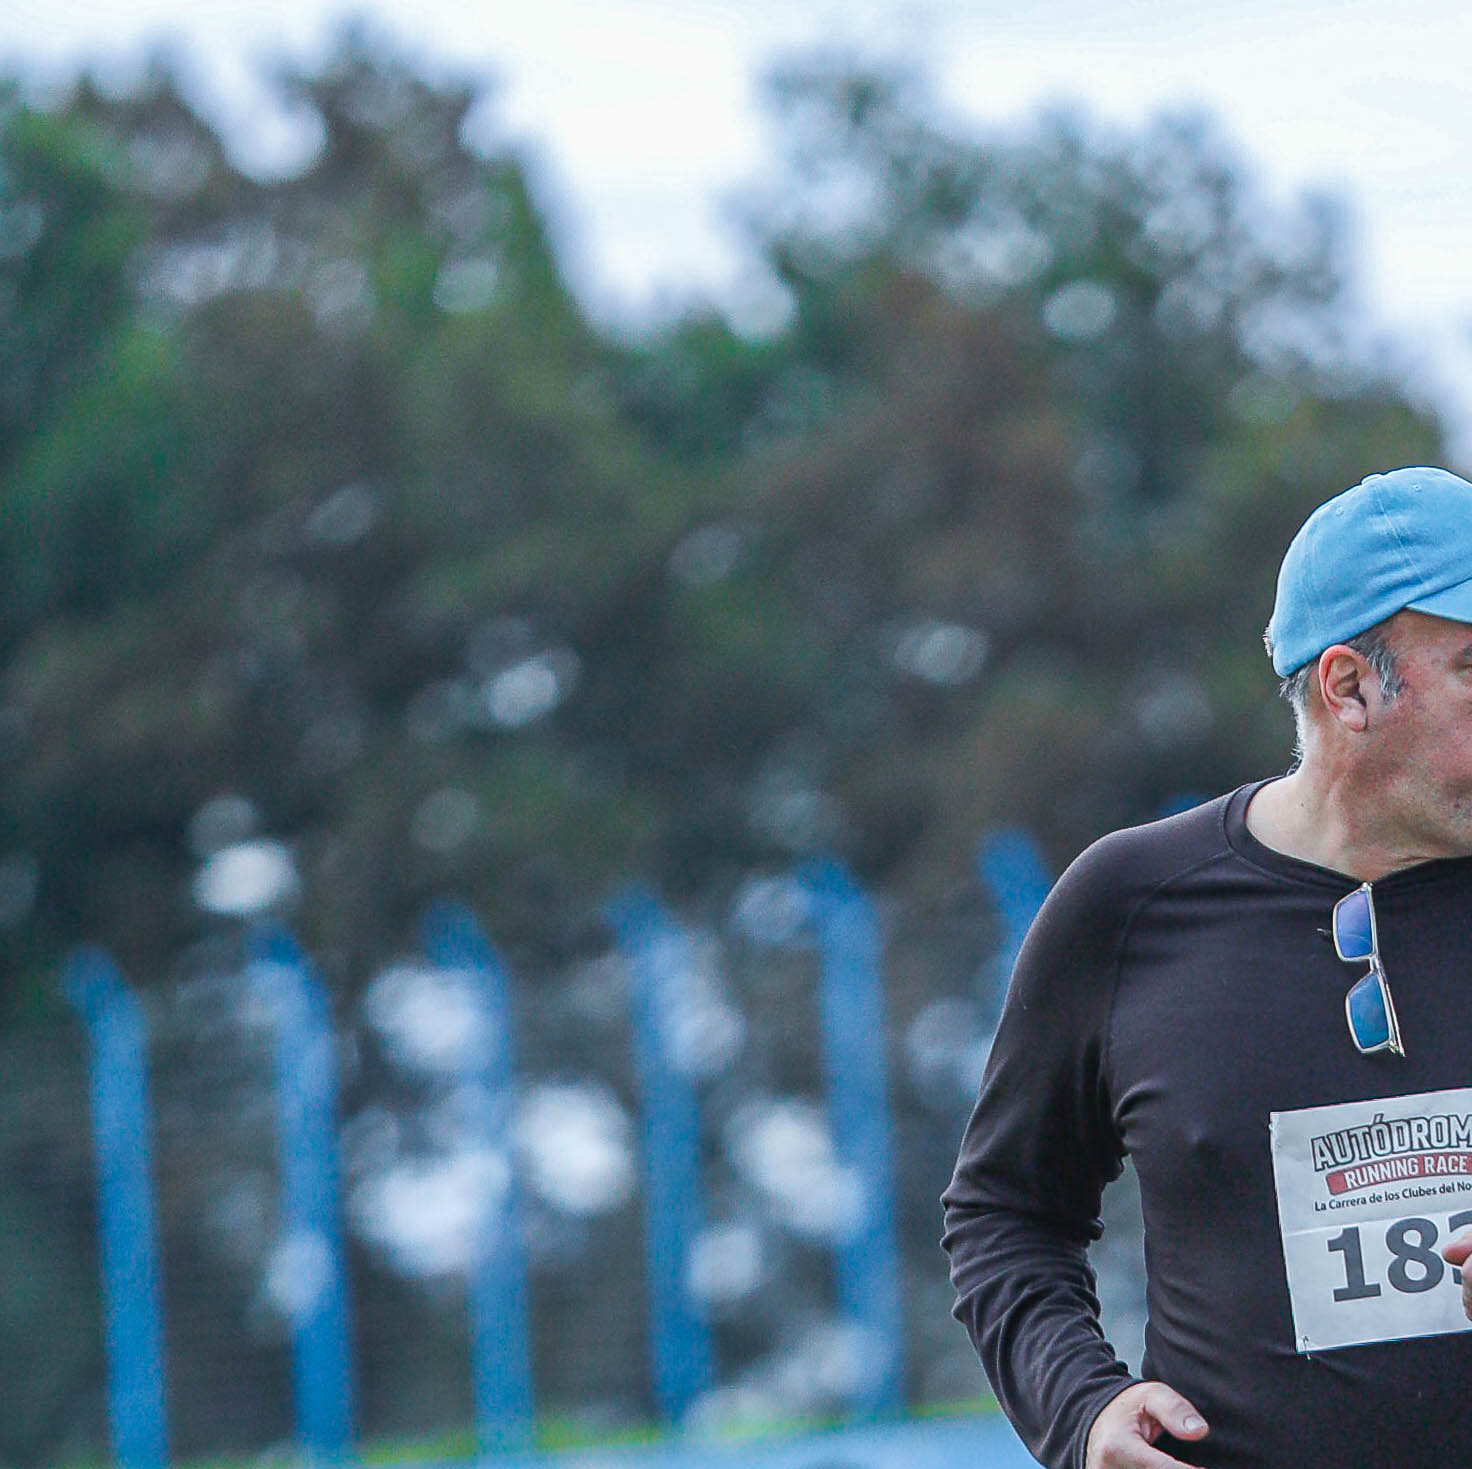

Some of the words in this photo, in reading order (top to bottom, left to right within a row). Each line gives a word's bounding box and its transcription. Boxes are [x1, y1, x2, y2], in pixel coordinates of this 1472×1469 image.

[1344, 1157, 1419, 1189] RUNNING
[1424, 1155, 1469, 1174] RACE
[1315, 1201, 1327, 1212] La
[1329, 1197, 1367, 1210] Carrera
[1369, 1193, 1383, 1205] de
[1385, 1191, 1400, 1202] los
[1402, 1184, 1437, 1200] Clubes
[1439, 1181, 1456, 1195] del
